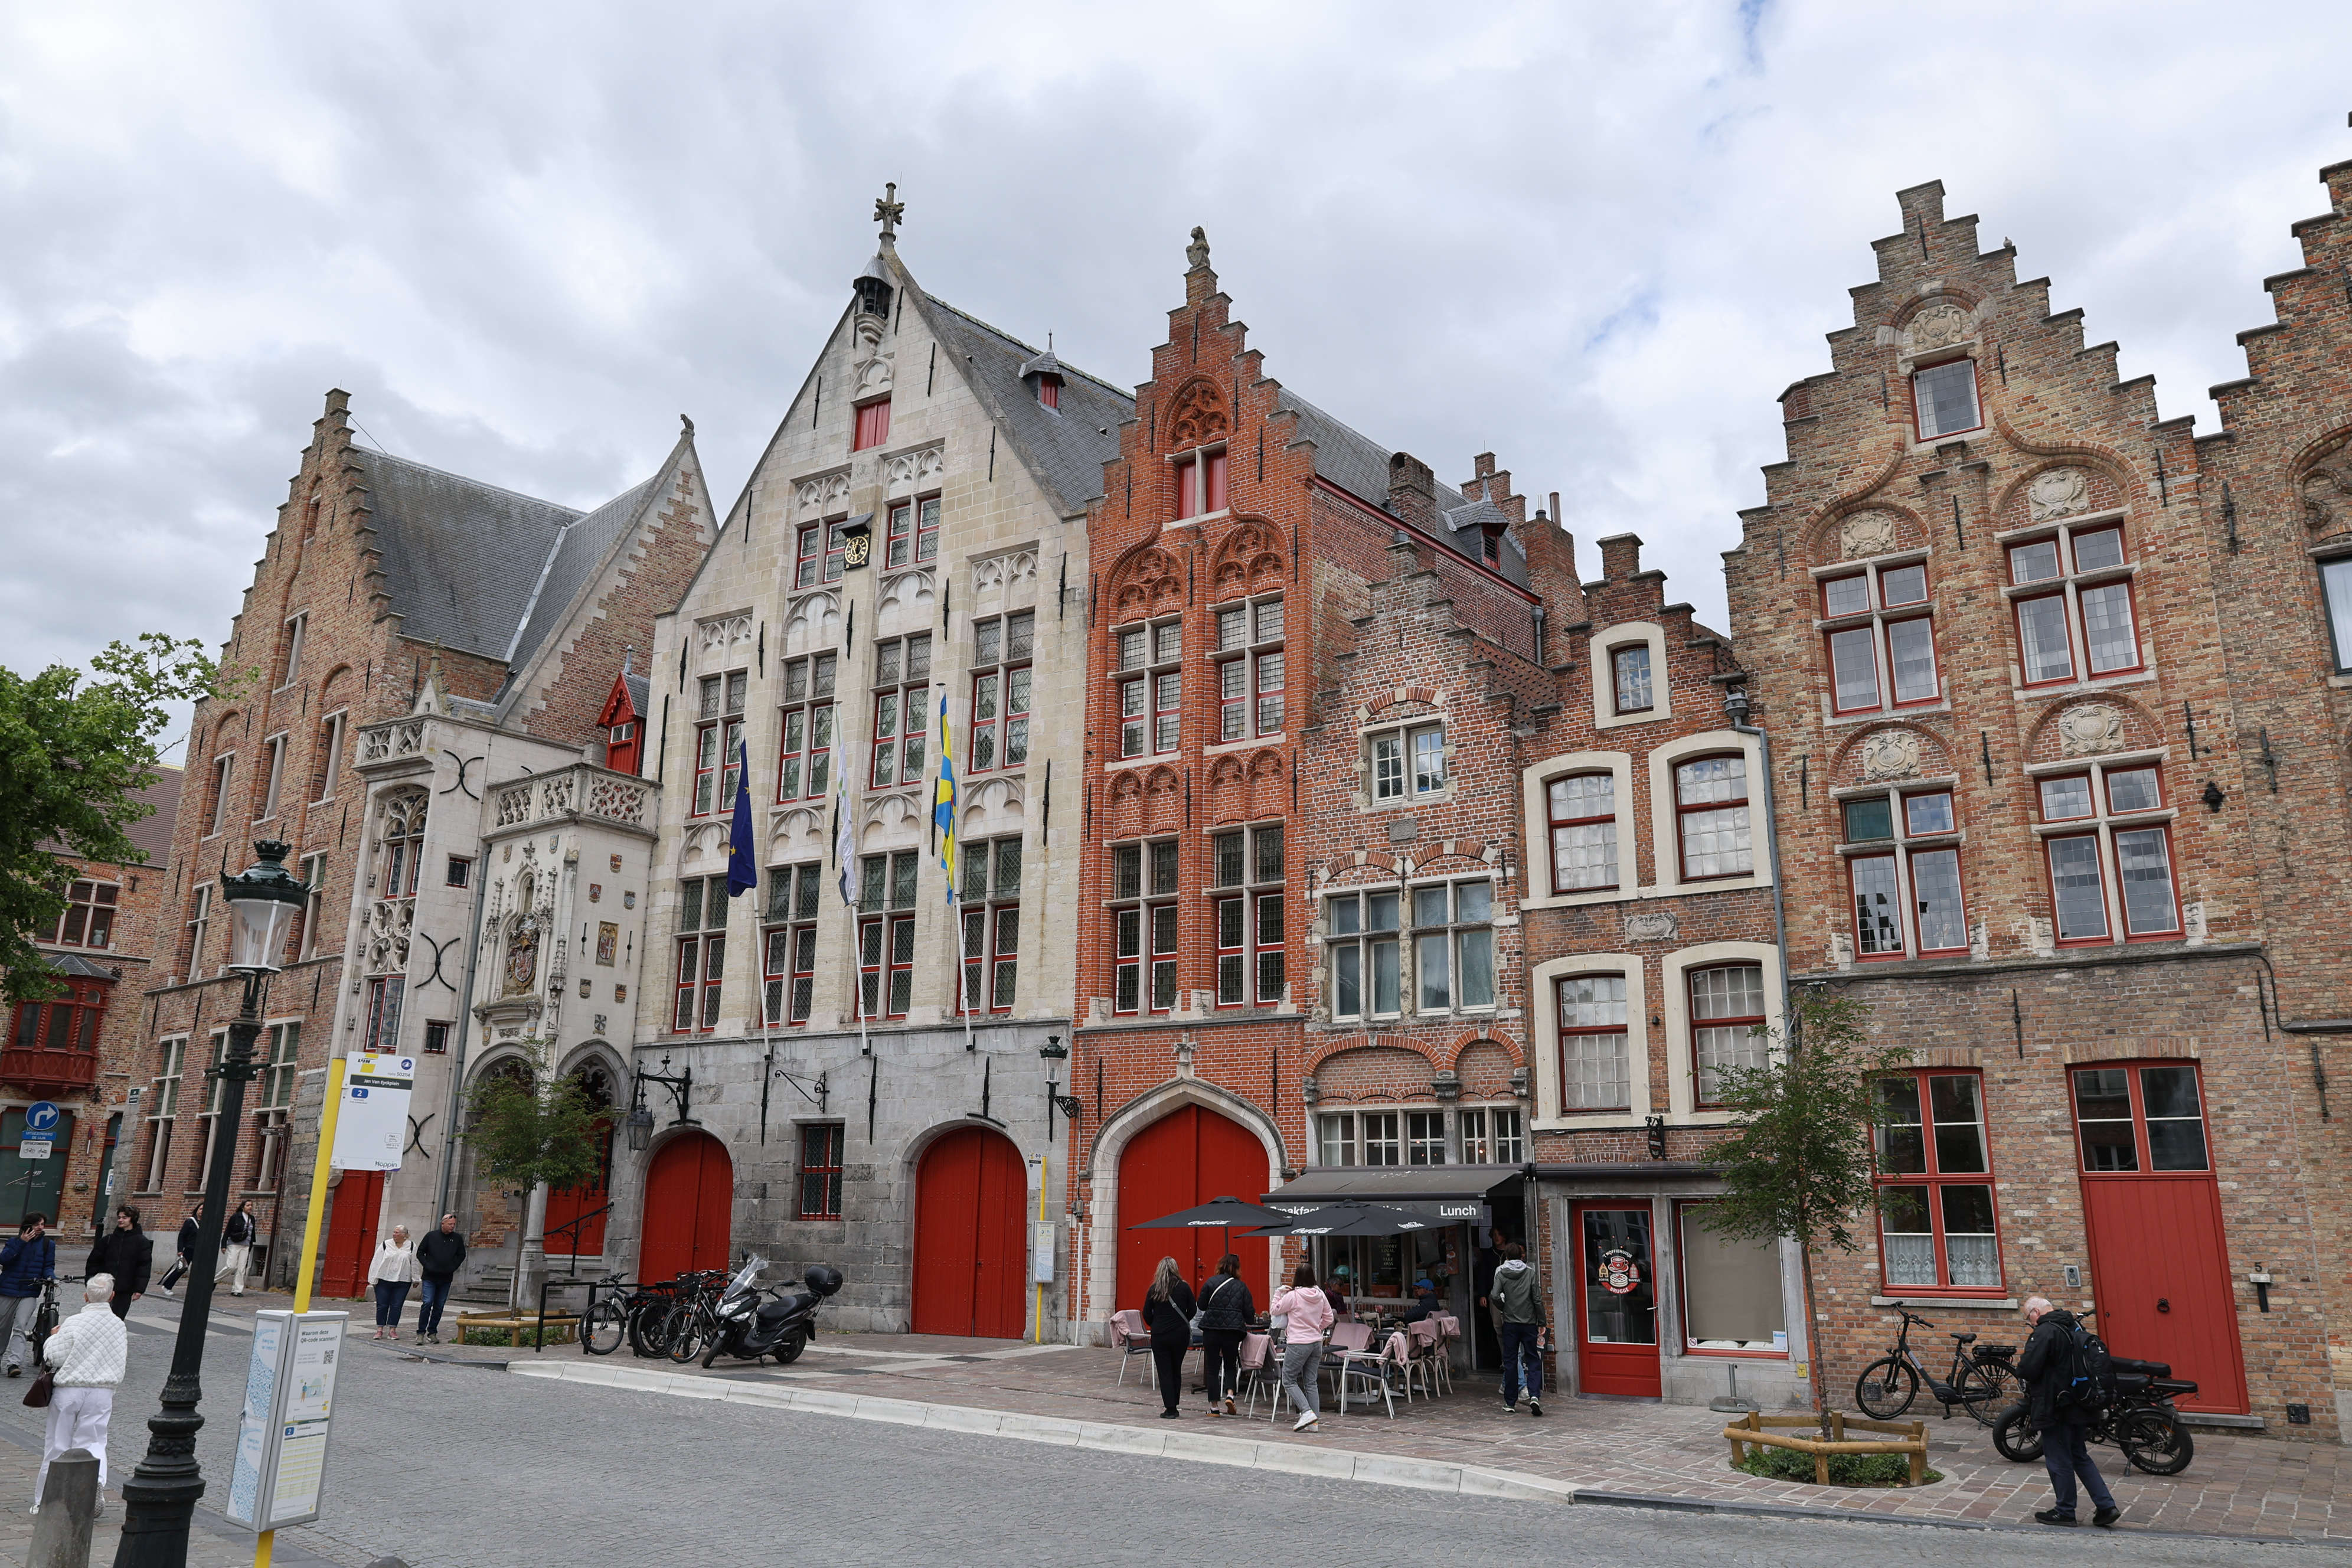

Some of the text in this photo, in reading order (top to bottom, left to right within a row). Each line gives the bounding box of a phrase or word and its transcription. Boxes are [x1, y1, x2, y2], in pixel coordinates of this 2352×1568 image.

[375, 1160, 397, 1168] Hoppin
[1440, 1205, 1476, 1216] Lunch
[2255, 1262, 2262, 1272] 5
